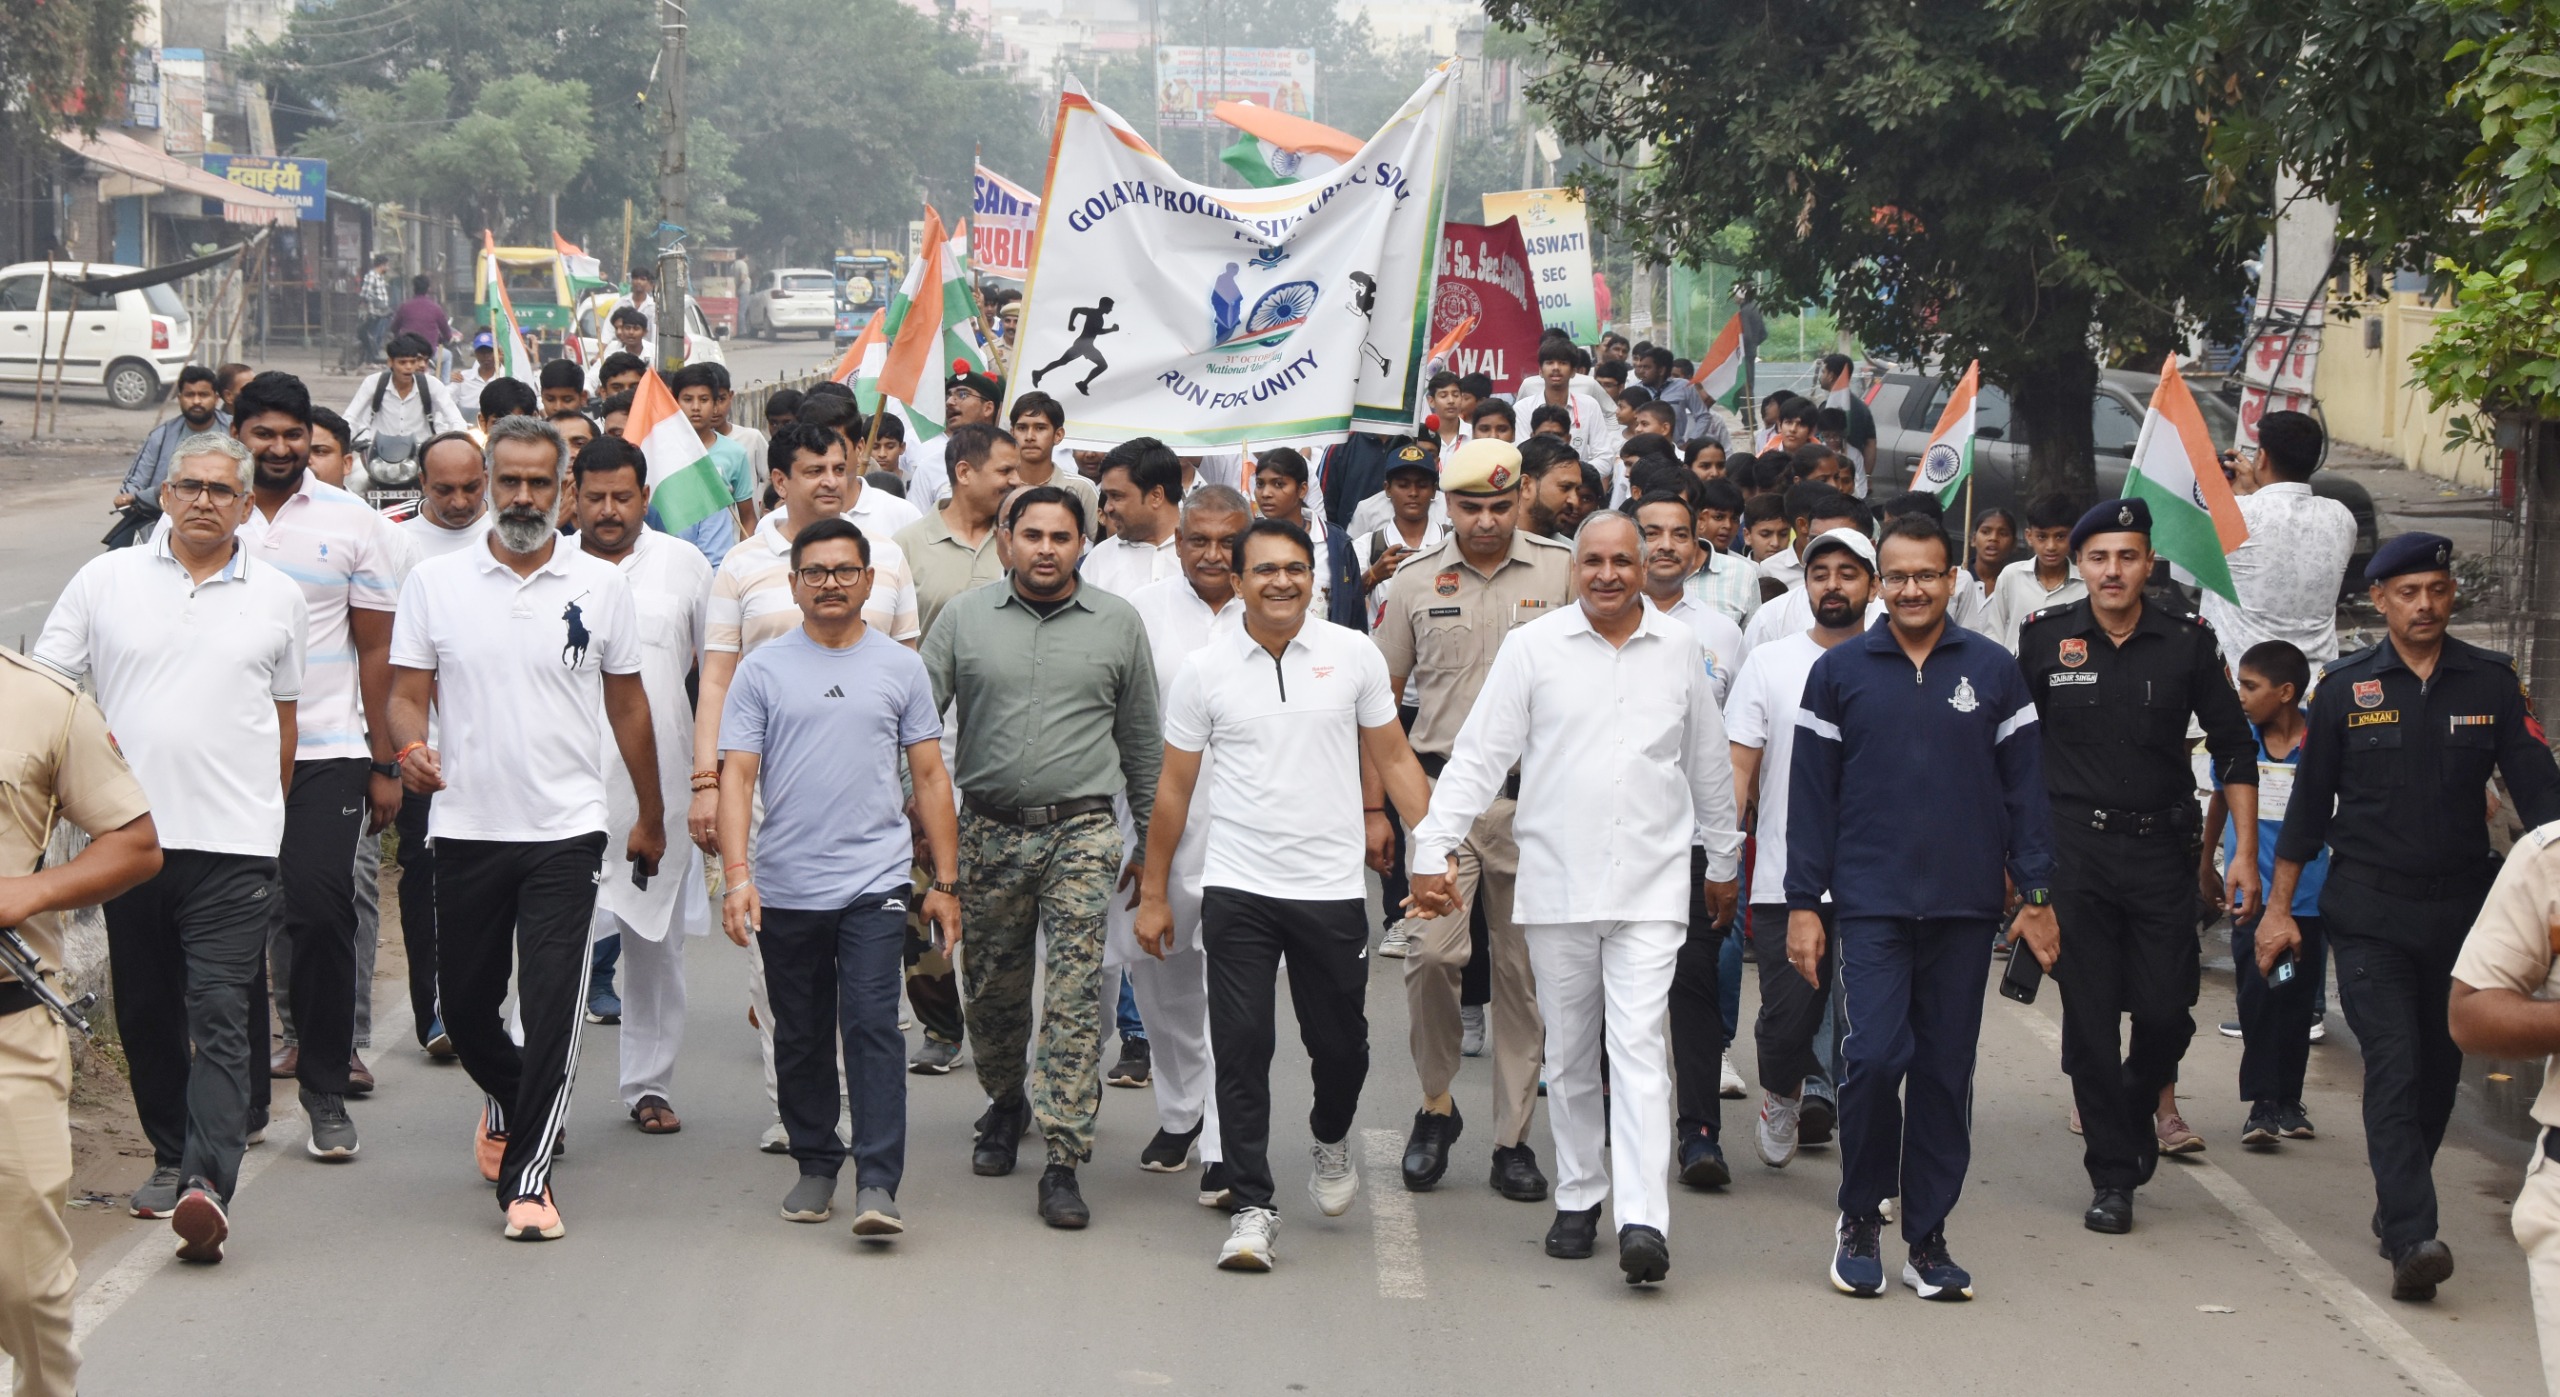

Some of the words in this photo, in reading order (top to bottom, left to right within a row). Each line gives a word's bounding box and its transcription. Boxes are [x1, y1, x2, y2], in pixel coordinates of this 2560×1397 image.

[1068, 181, 1150, 232] GOLAYA
[973, 227, 1034, 269] PUBLI
[1526, 232, 1584, 256] ASWATI
[1542, 266, 1567, 283] SEC
[1538, 293, 1571, 310] HOOL
[514, 310, 533, 318] AXY
[1157, 370, 1209, 406] RUN
[1209, 390, 1248, 409] FOR
[1252, 349, 1319, 402] UNITY
[1206, 363, 1249, 375] National
